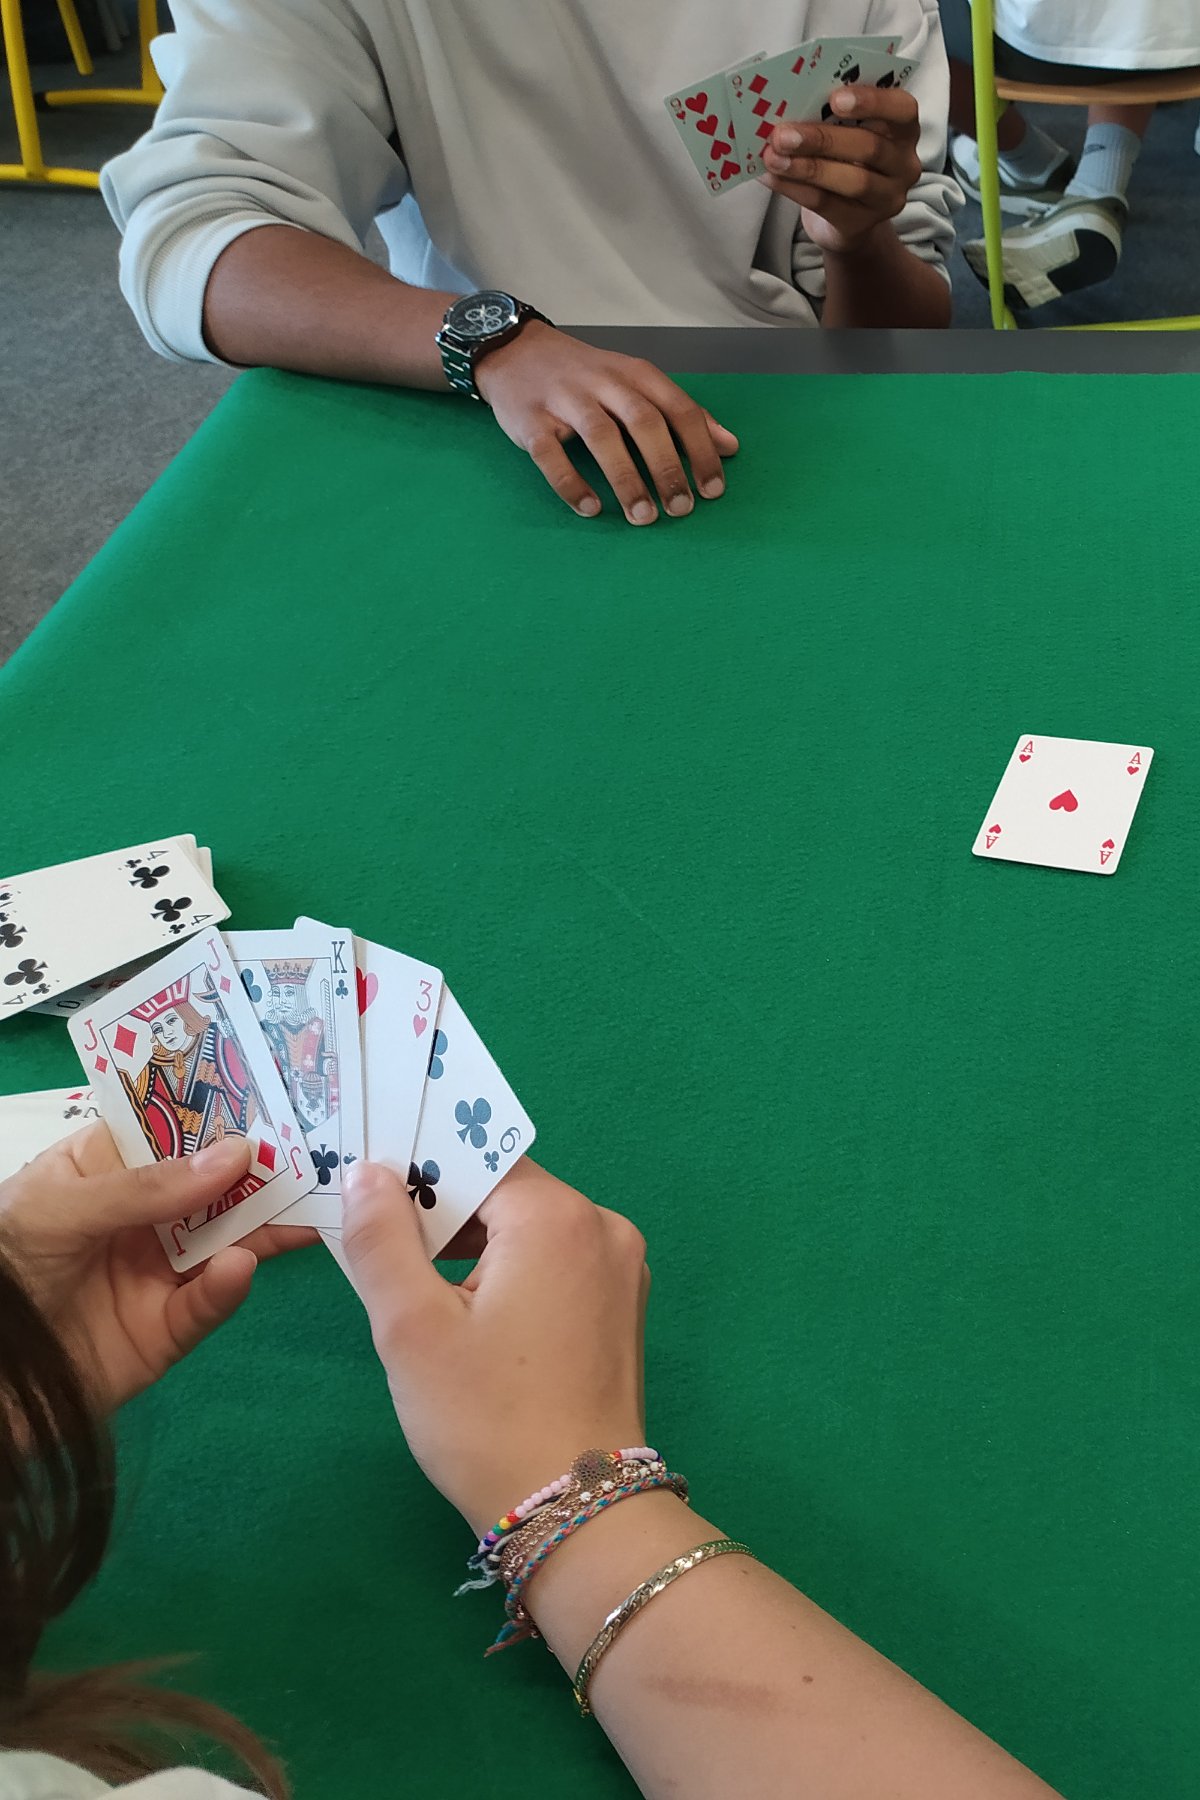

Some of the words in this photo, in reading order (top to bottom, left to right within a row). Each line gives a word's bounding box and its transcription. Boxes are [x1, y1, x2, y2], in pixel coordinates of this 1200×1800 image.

[1021, 740, 1034, 754] A
[1129, 751, 1142, 766] A
[985, 835, 999, 850] A
[1099, 850, 1114, 866] A
[191, 913, 214, 927] 4
[206, 938, 221, 971] J
[330, 940, 348, 974] K
[415, 979, 433, 1012] 3
[84, 1018, 98, 1052] J
[500, 1126, 522, 1154] 6
[287, 1145, 303, 1180] J
[170, 1221, 187, 1257] J
